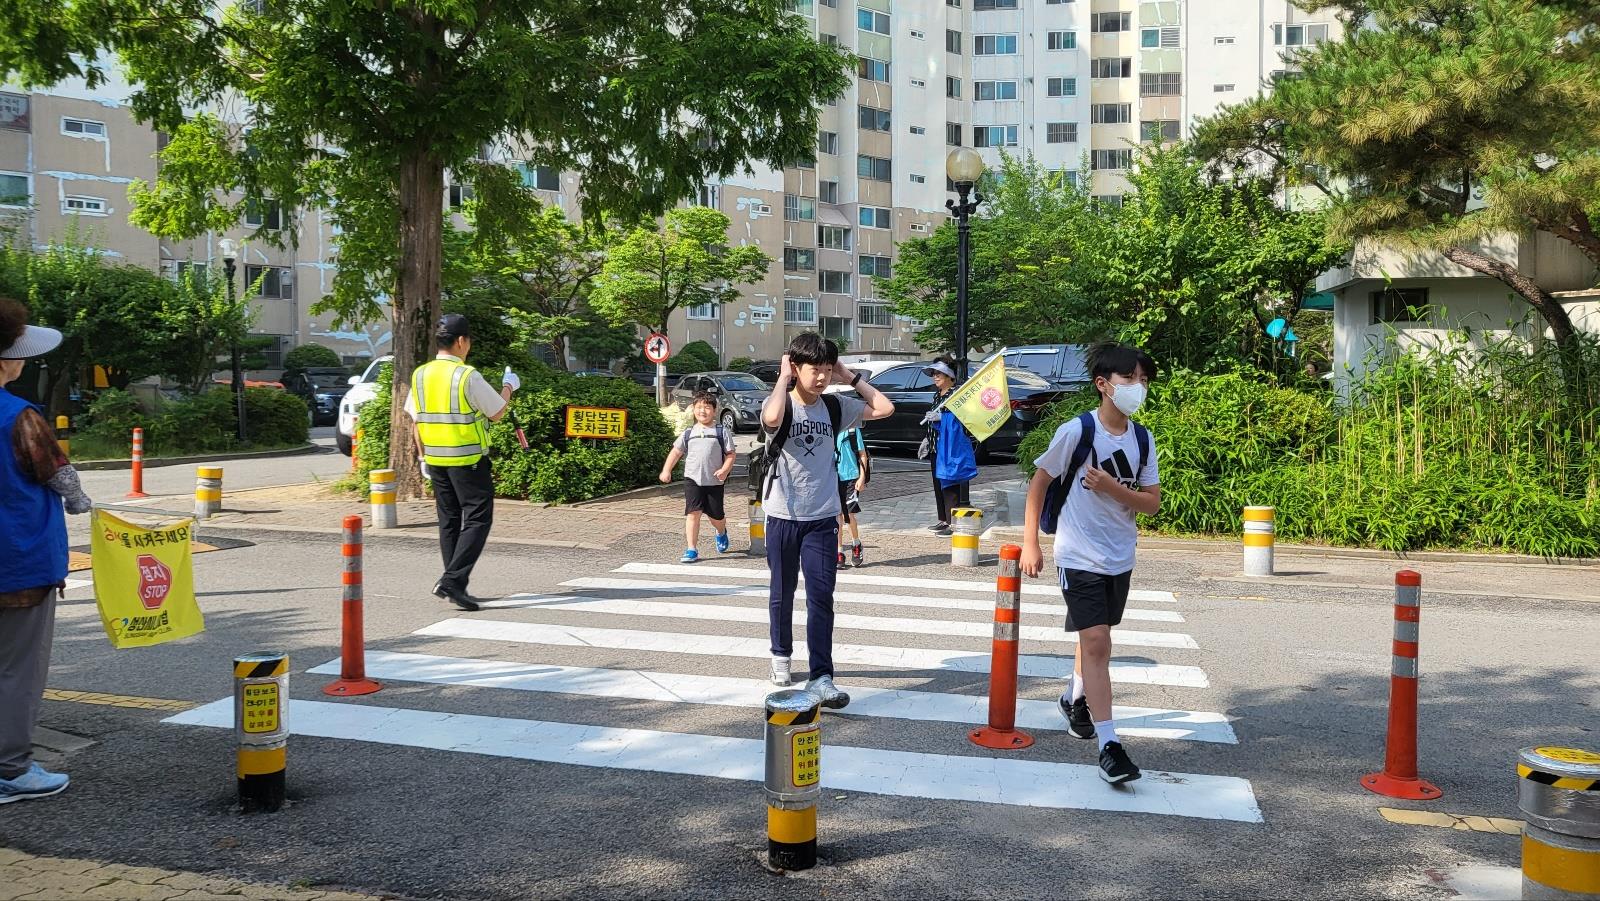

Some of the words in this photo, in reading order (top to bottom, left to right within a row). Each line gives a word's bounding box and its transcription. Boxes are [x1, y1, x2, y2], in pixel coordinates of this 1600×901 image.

[573, 410, 621, 422] 횡단보도
[572, 422, 621, 435] 주차금지
[140, 564, 167, 581] 정지
[143, 585, 168, 599] STOP
